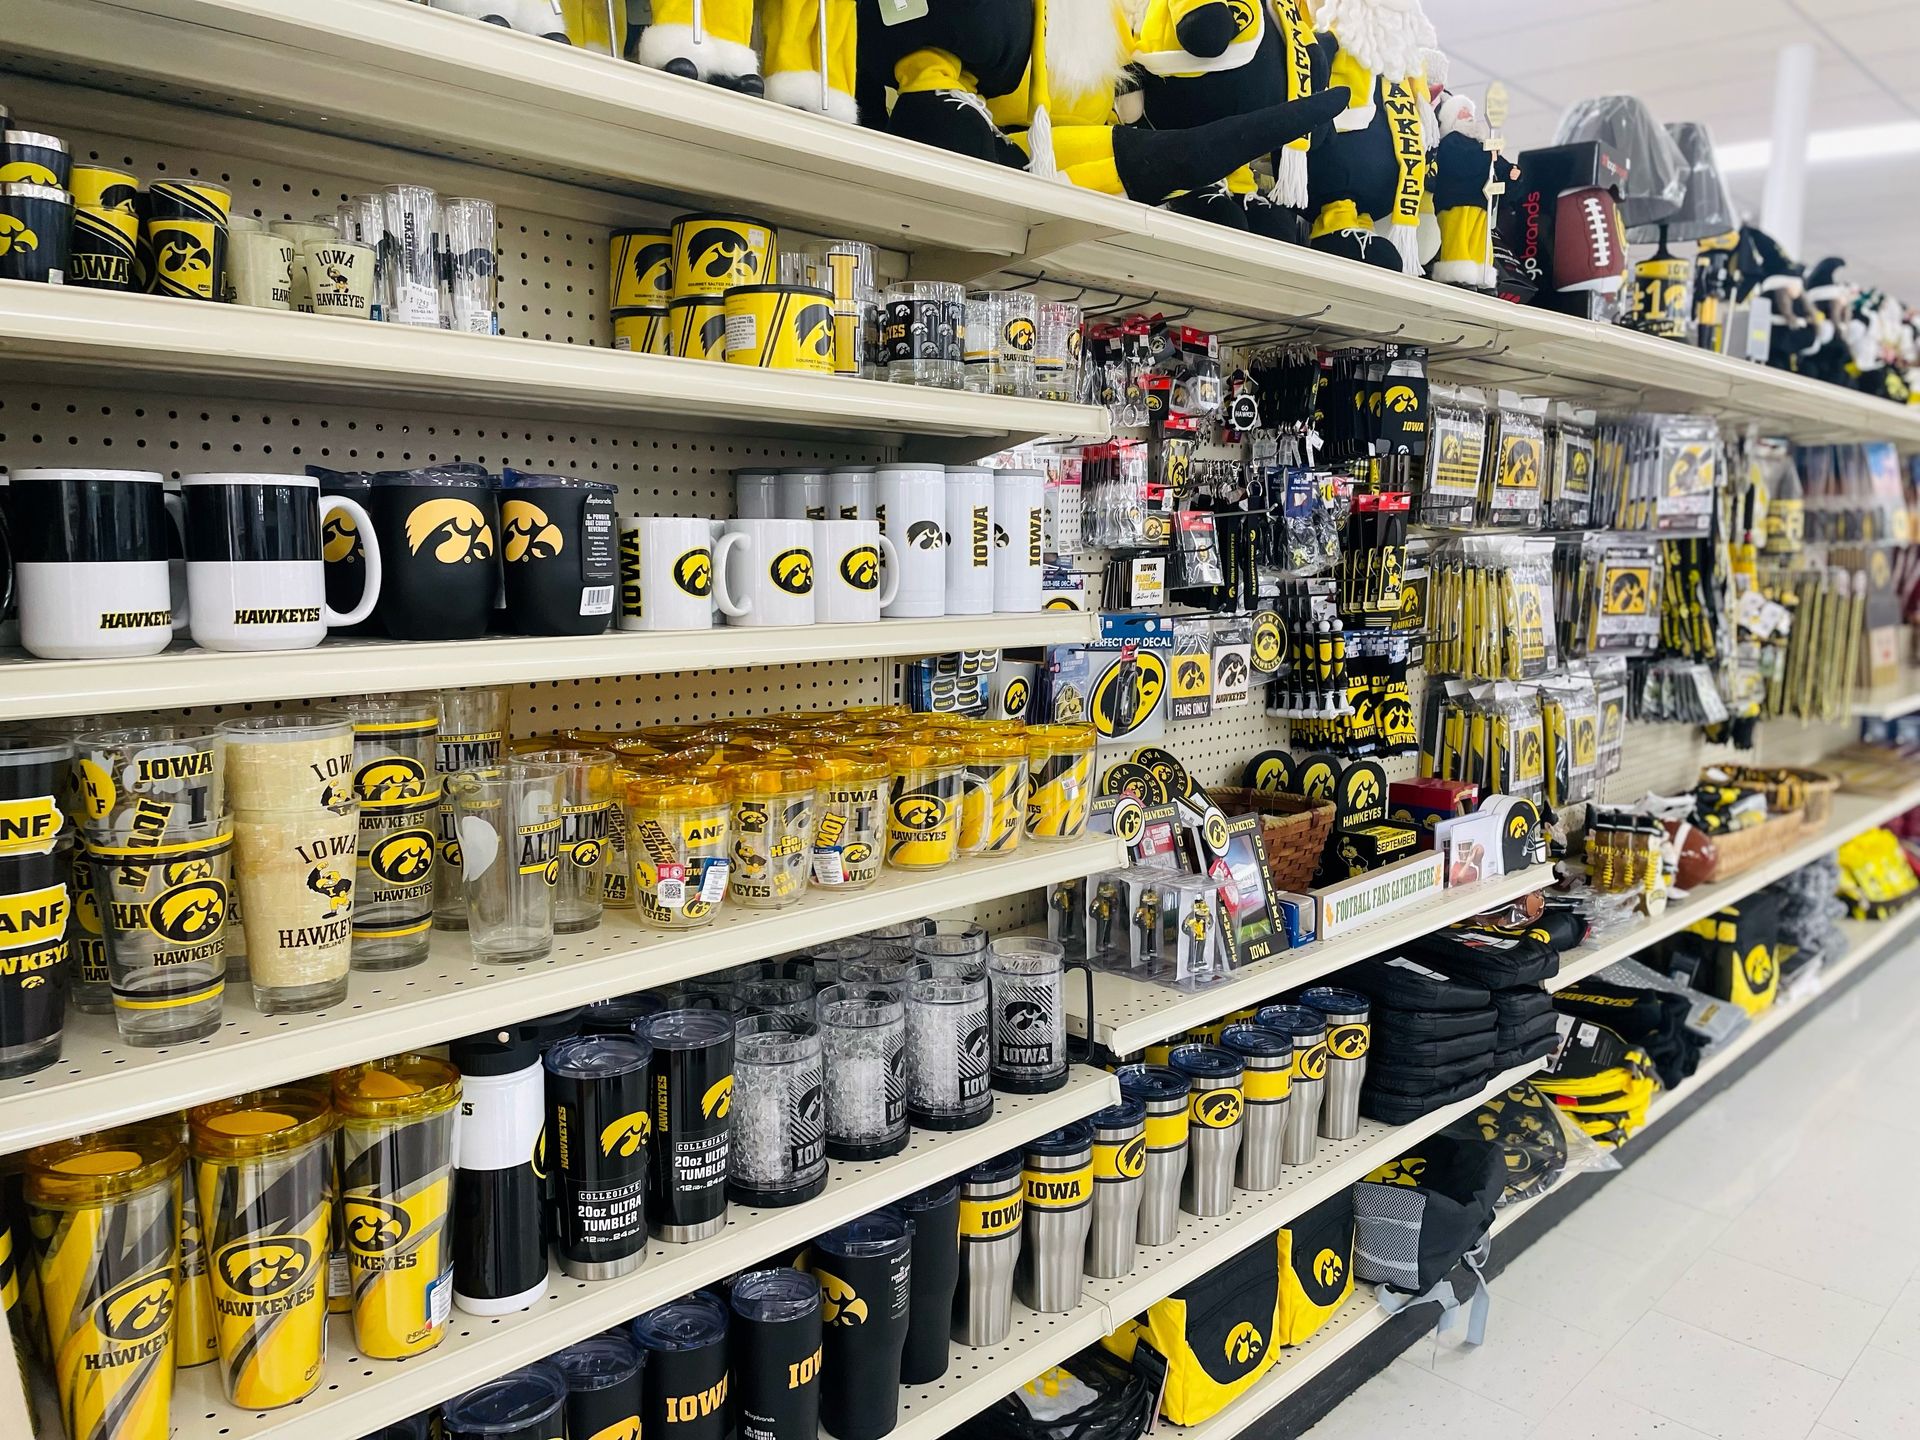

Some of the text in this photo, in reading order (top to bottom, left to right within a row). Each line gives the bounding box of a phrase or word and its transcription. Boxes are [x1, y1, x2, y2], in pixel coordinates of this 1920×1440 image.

[1386, 83, 1422, 217] AWKEYES
[70, 253, 129, 284] OWA
[315, 250, 354, 269] IOWA
[316, 293, 365, 309] HAWKEYES
[1403, 421, 1424, 432] IOWA
[973, 506, 988, 567] IOWA
[1029, 507, 1042, 567] IOWA
[620, 528, 642, 617] IOWA
[234, 608, 320, 624] HAWKEYES
[1090, 637, 1123, 648] PERFECT
[1143, 637, 1172, 647] DECAL
[1215, 691, 1247, 703] HAWKEYES
[1176, 701, 1208, 717] FANS ONLY
[1354, 725, 1376, 739] HAWK
[138, 751, 214, 782] IOWA
[436, 741, 500, 772] UMNI
[1140, 751, 1161, 765] OWA
[311, 754, 352, 782] IOW
[80, 765, 106, 814] ANF
[829, 790, 878, 802] IOWA
[1091, 799, 1117, 811] WKEYES
[0, 814, 51, 840] NF
[359, 813, 425, 830] HAWKEYES
[1343, 806, 1382, 828] HAWKEYES
[688, 824, 724, 841] ANF
[815, 813, 848, 848] IOW
[891, 830, 946, 842] HAWKEYES
[520, 829, 561, 865] ALU
[781, 836, 799, 847] Go
[1377, 834, 1416, 853] SEPTEMBER
[636, 863, 650, 886] ANF
[373, 881, 433, 903] HAWKEYES
[640, 891, 671, 912] WA
[734, 886, 771, 897] KEYES
[1262, 865, 1282, 932] HAWKS
[1335, 866, 1435, 924] FOOTBALL FANS GATHER HERE
[643, 907, 670, 922] KEYES
[279, 916, 352, 948] HAWKEY
[79, 940, 105, 966] IO
[153, 938, 225, 967] HAWKEYES
[1249, 941, 1271, 960] IOWA
[1003, 1046, 1050, 1064] IOWA
[963, 1078, 990, 1098] IOW
[658, 1076, 667, 1132] HAWKEYES
[889, 1104, 905, 1123] IO
[560, 1105, 569, 1170] HAWKEYES
[677, 1133, 729, 1151] COLLEGIATE
[675, 1145, 728, 1168] 20oz ULTRA
[797, 1143, 824, 1168] IOW
[680, 1160, 726, 1181] TUMBLER
[580, 1183, 640, 1200] COLLEGIATE
[706, 1177, 719, 1187] 24
[1028, 1180, 1081, 1199] IOWA
[578, 1195, 642, 1217] 20oz ULTRA
[982, 1201, 1023, 1229] IOWA
[583, 1211, 638, 1232] TUMBLER
[613, 1231, 628, 1241] 24
[217, 1284, 316, 1317] HAWKEYES
[85, 1331, 170, 1370] HAWKEY
[666, 1370, 728, 1423] IOWA
